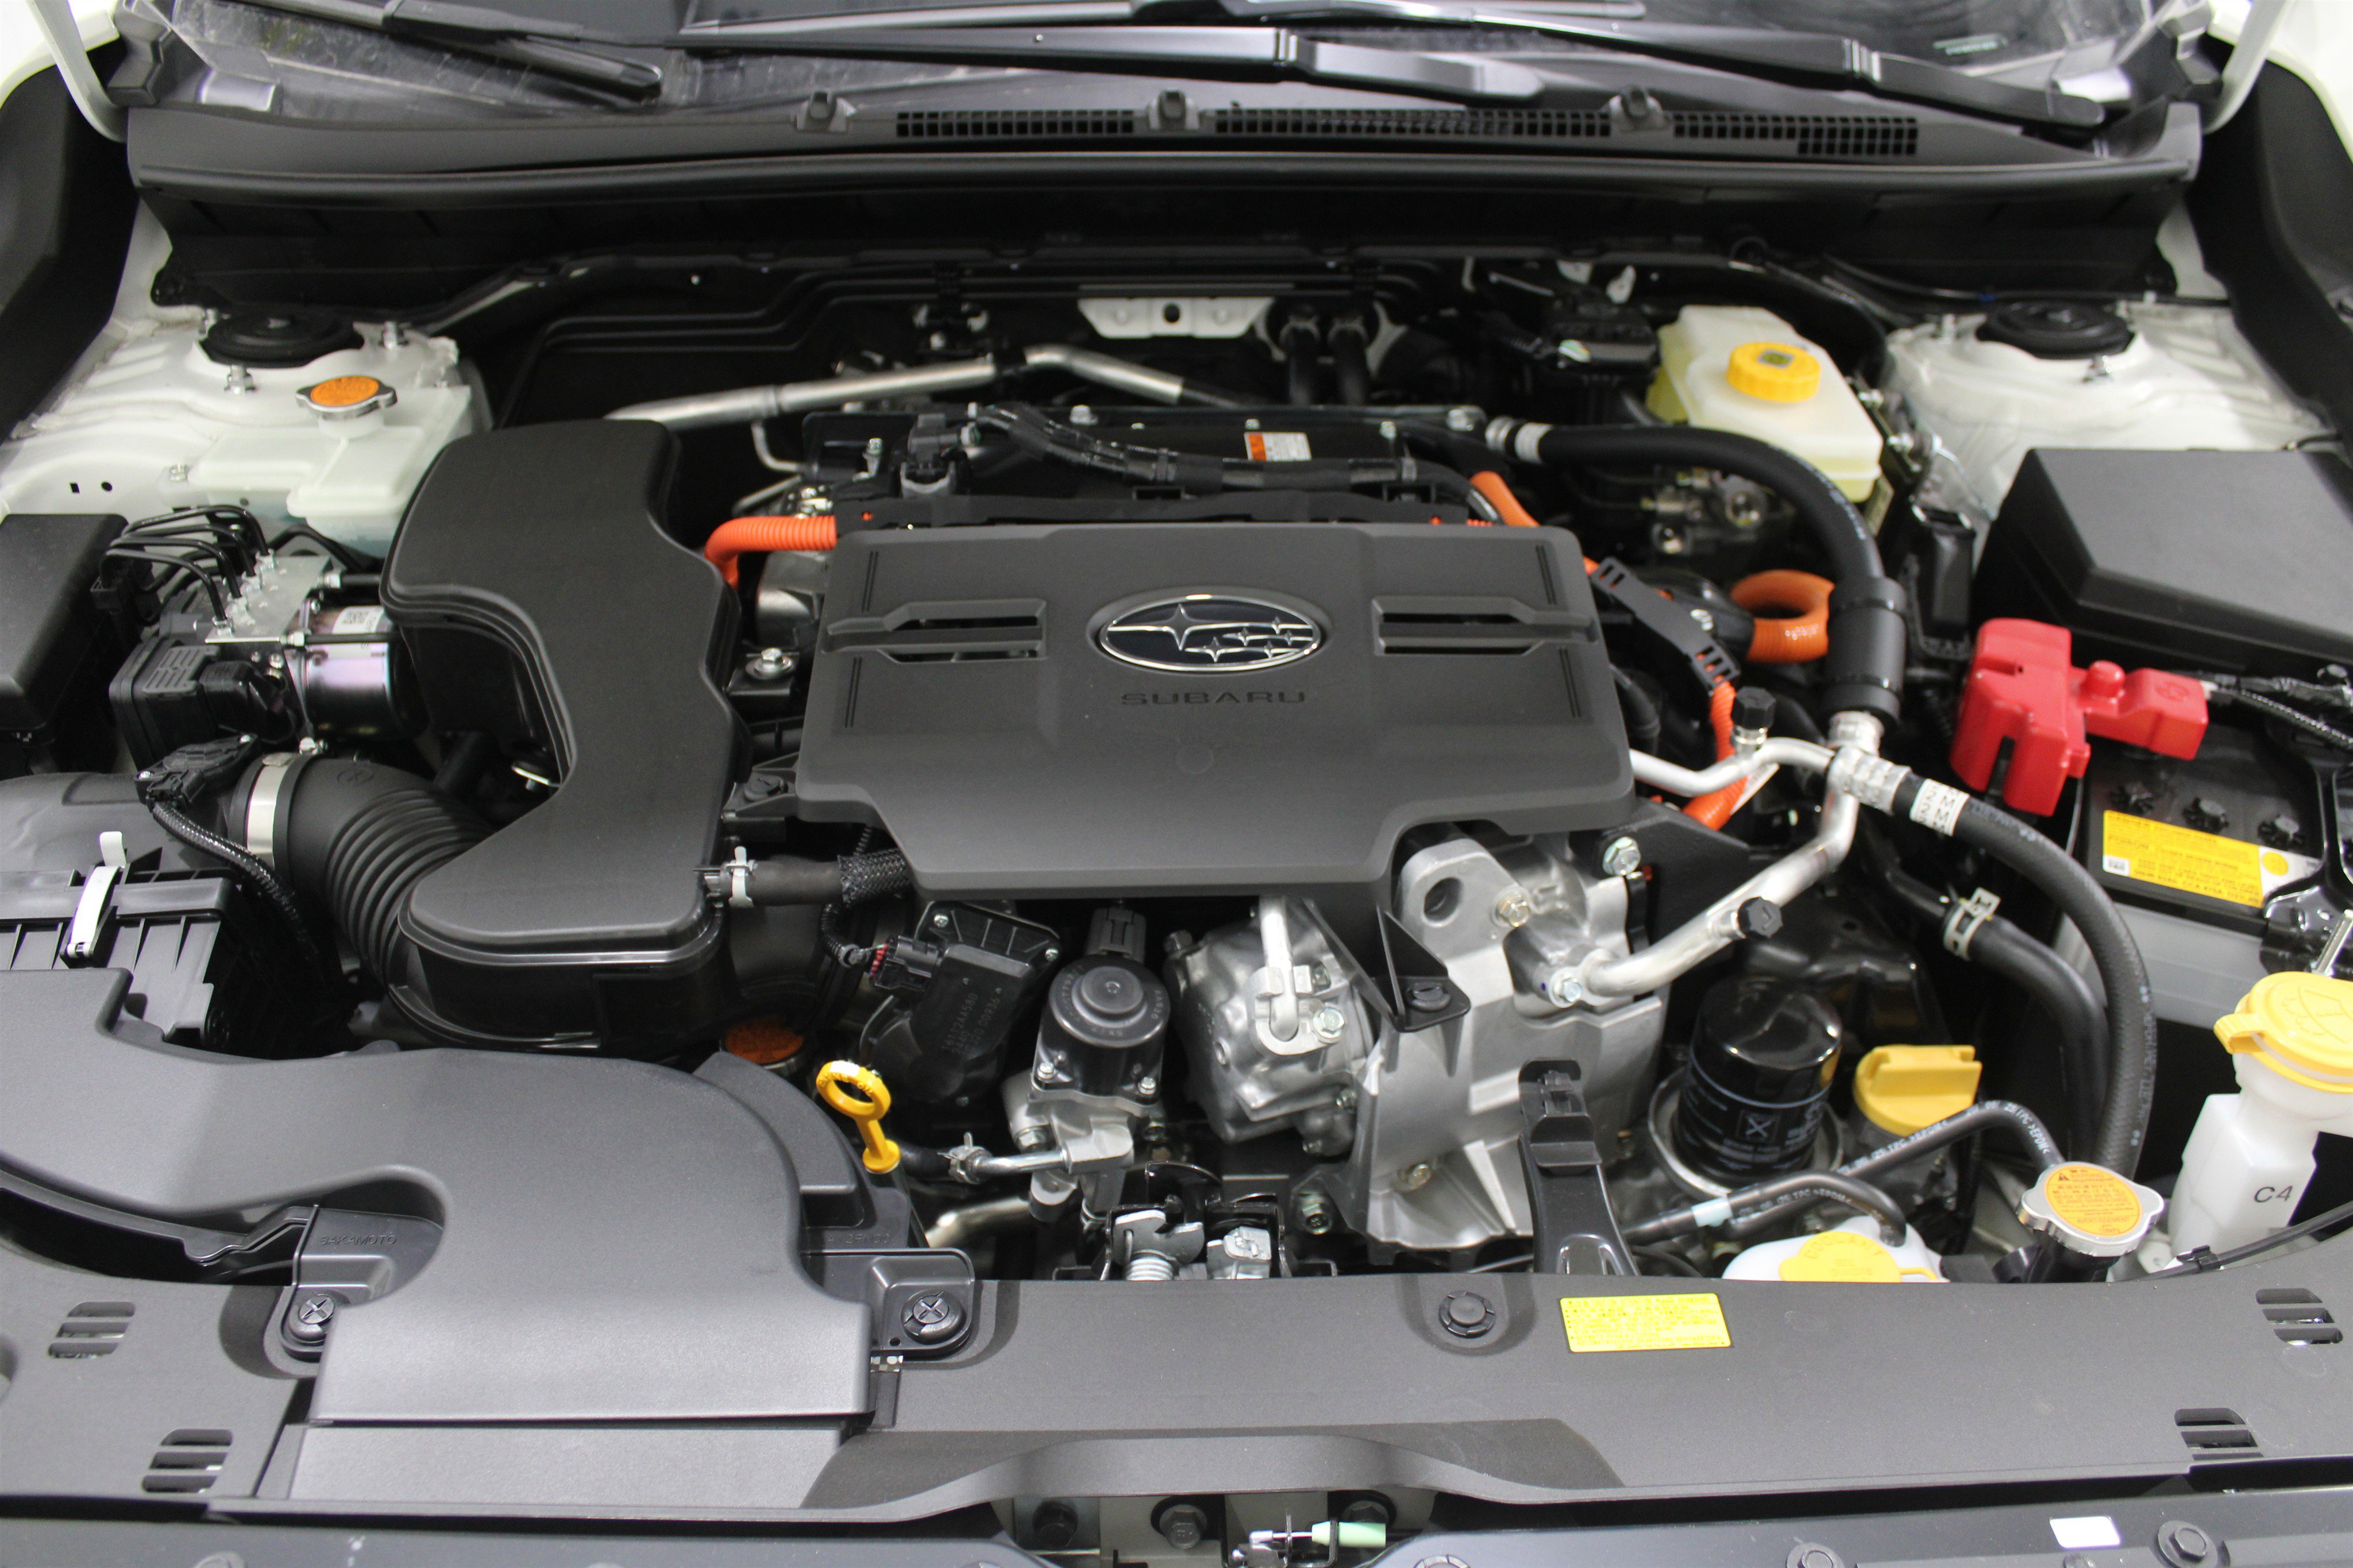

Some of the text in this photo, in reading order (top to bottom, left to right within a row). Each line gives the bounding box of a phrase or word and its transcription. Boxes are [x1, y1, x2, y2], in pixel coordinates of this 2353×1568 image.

[1121, 690, 1305, 705] SUBARU
[2254, 1186, 2293, 1203] C4
[321, 1235, 397, 1245] SAKAMOTO
[1804, 1234, 1885, 1260] COOLANT
